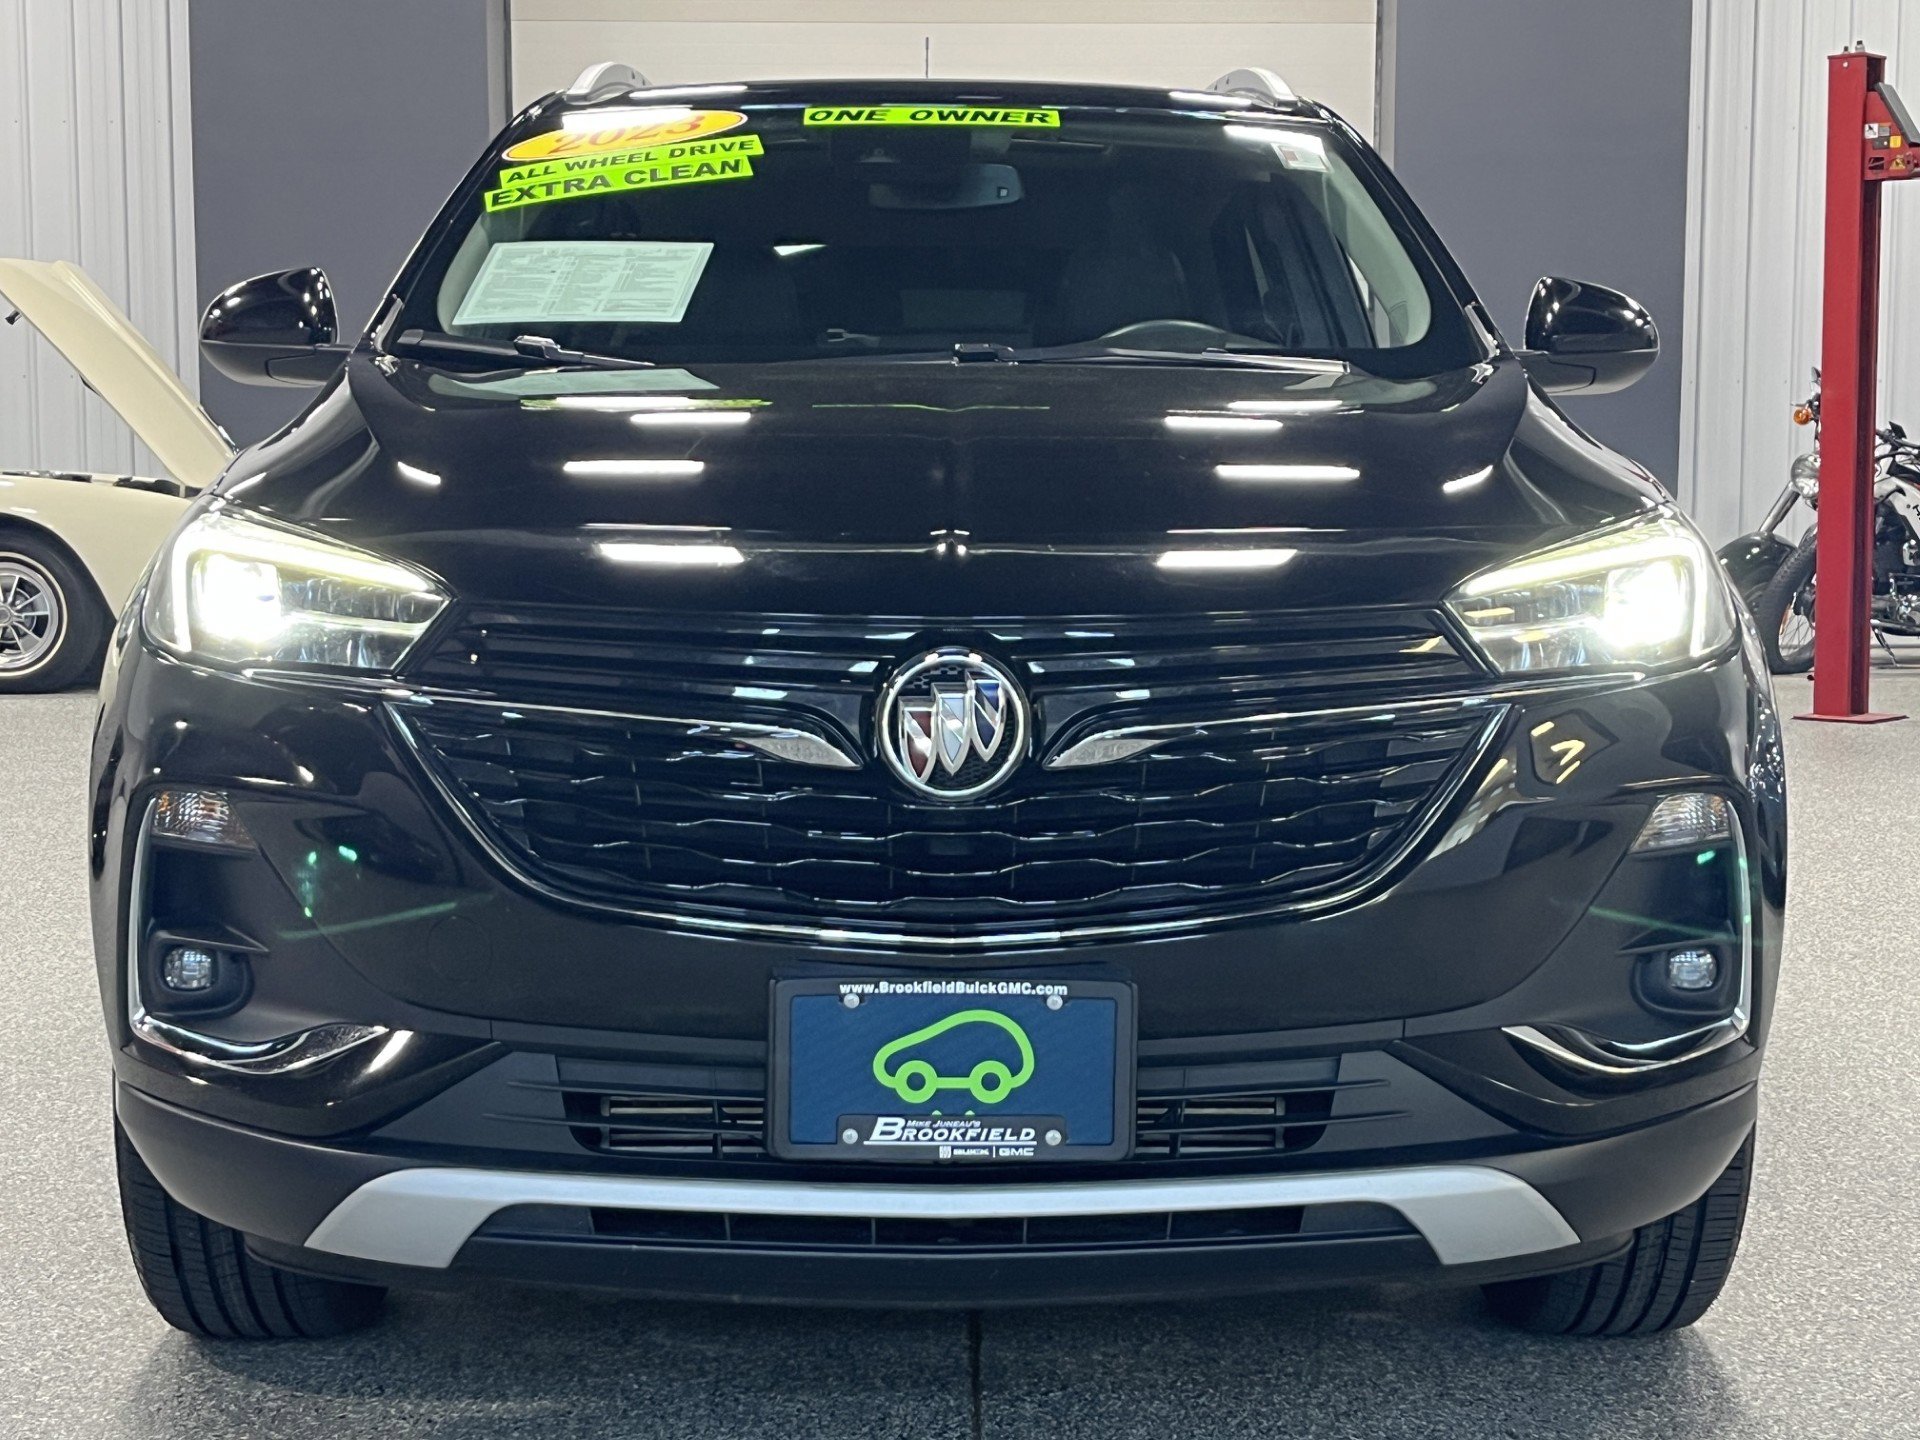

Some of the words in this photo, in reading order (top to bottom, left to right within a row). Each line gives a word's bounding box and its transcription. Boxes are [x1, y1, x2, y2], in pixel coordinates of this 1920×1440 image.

[808, 109, 891, 122] ONE
[909, 109, 1051, 124] OWNER
[547, 115, 706, 155] 2023
[506, 165, 557, 184] ALL
[564, 151, 658, 172] WHEEL
[668, 139, 755, 159] DRIVE
[491, 174, 612, 208] EXTRA
[624, 158, 743, 185] CLEAN
[839, 981, 1068, 996] www.BrookfieldBuickGMC.com
[998, 1147, 1035, 1156] GMC
